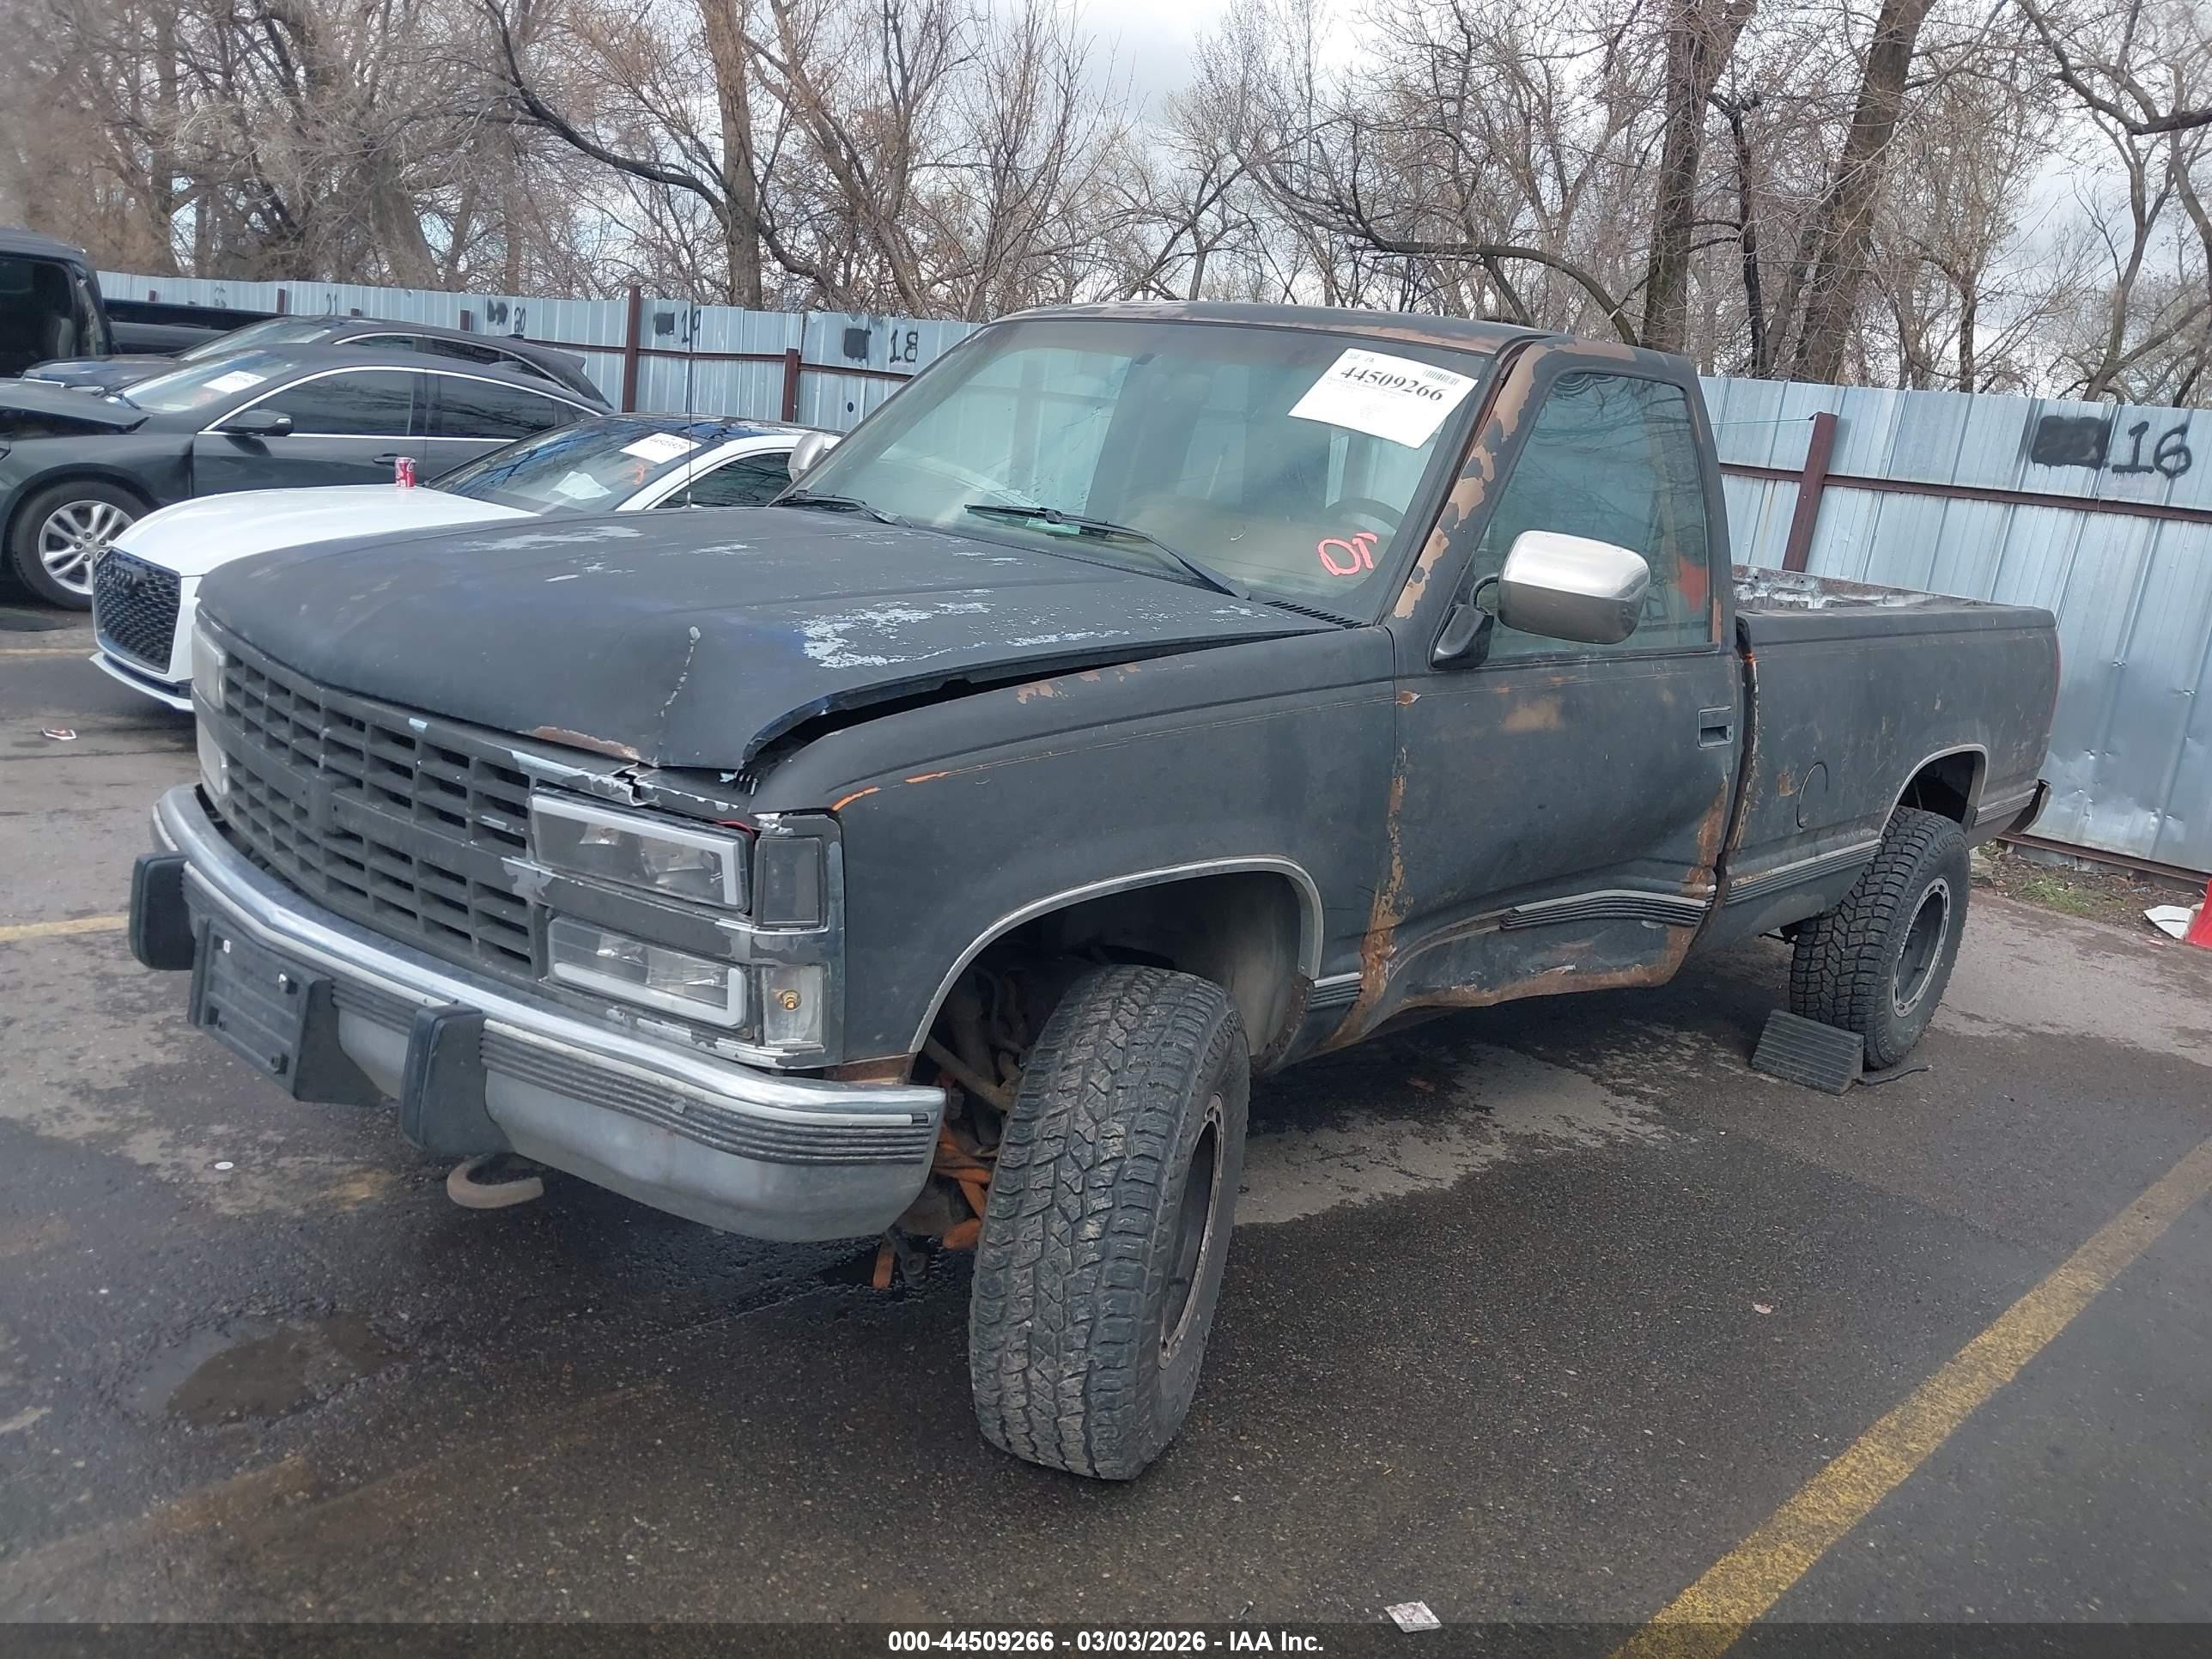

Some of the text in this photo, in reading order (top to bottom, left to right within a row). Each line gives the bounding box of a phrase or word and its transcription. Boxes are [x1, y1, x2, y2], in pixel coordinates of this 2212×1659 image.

[681, 309, 702, 349] 19
[890, 330, 919, 364] 18
[1340, 366, 1448, 401] 44509266
[2112, 421, 2192, 479] 16
